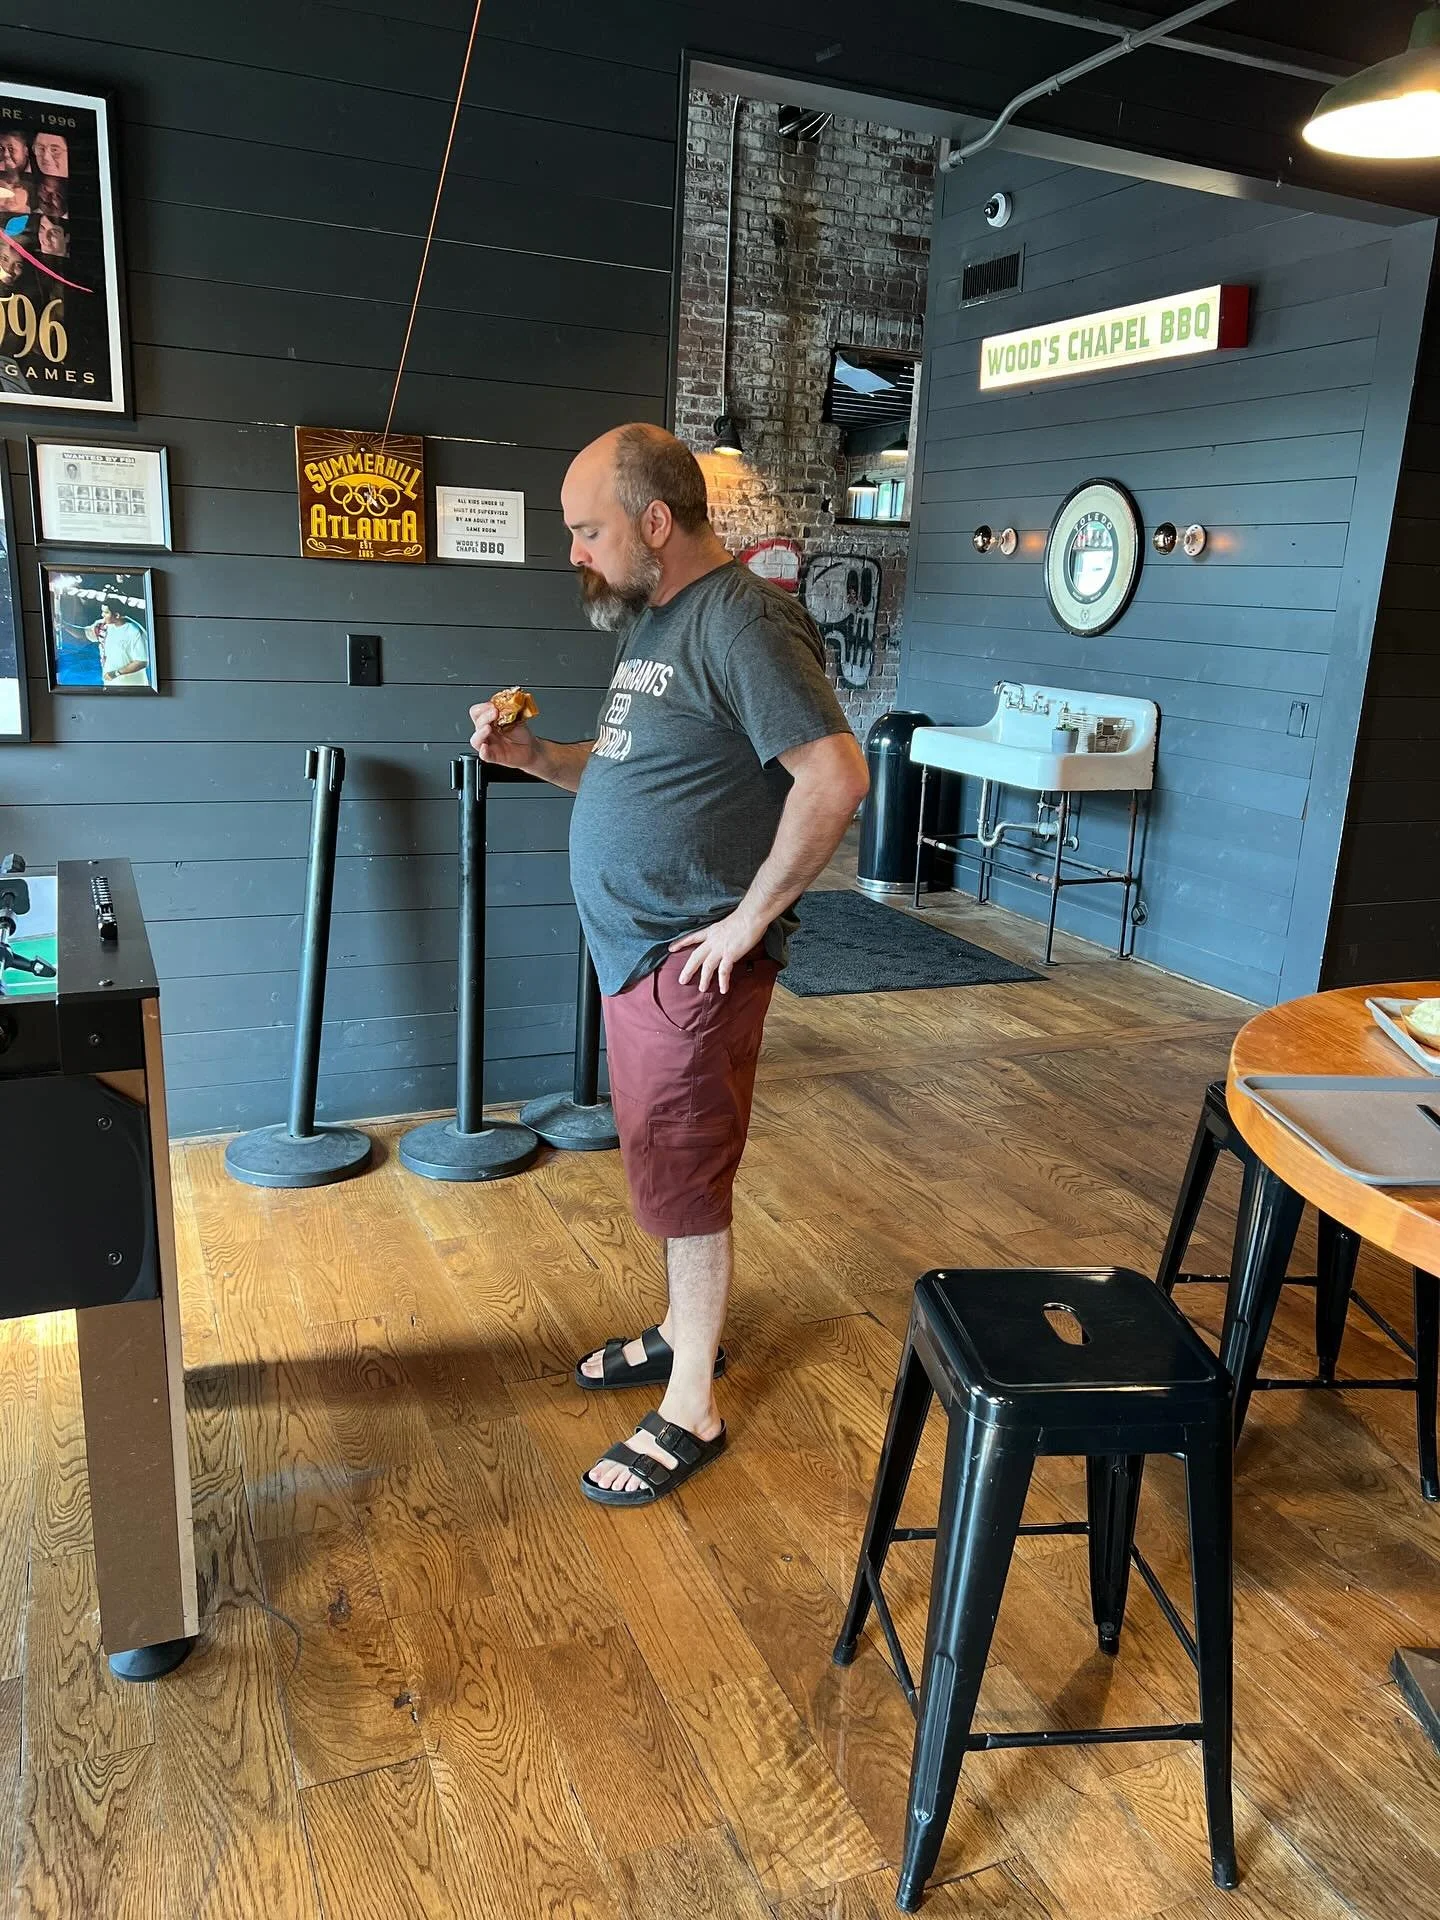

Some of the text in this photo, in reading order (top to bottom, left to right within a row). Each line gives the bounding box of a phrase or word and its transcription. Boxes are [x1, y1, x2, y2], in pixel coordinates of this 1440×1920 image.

[0, 107, 77, 128] RE 1996
[0, 293, 68, 363] 96
[987, 302, 1211, 376] WOOD'S CHAPEL BBQ
[4, 364, 95, 384] GAMES
[63, 453, 104, 461] WANTED
[304, 453, 422, 500] SUMMERHILL
[309, 504, 418, 543] ATLANTA
[1073, 512, 1113, 532] TOLEDO
[480, 542, 504, 555] BBQ
